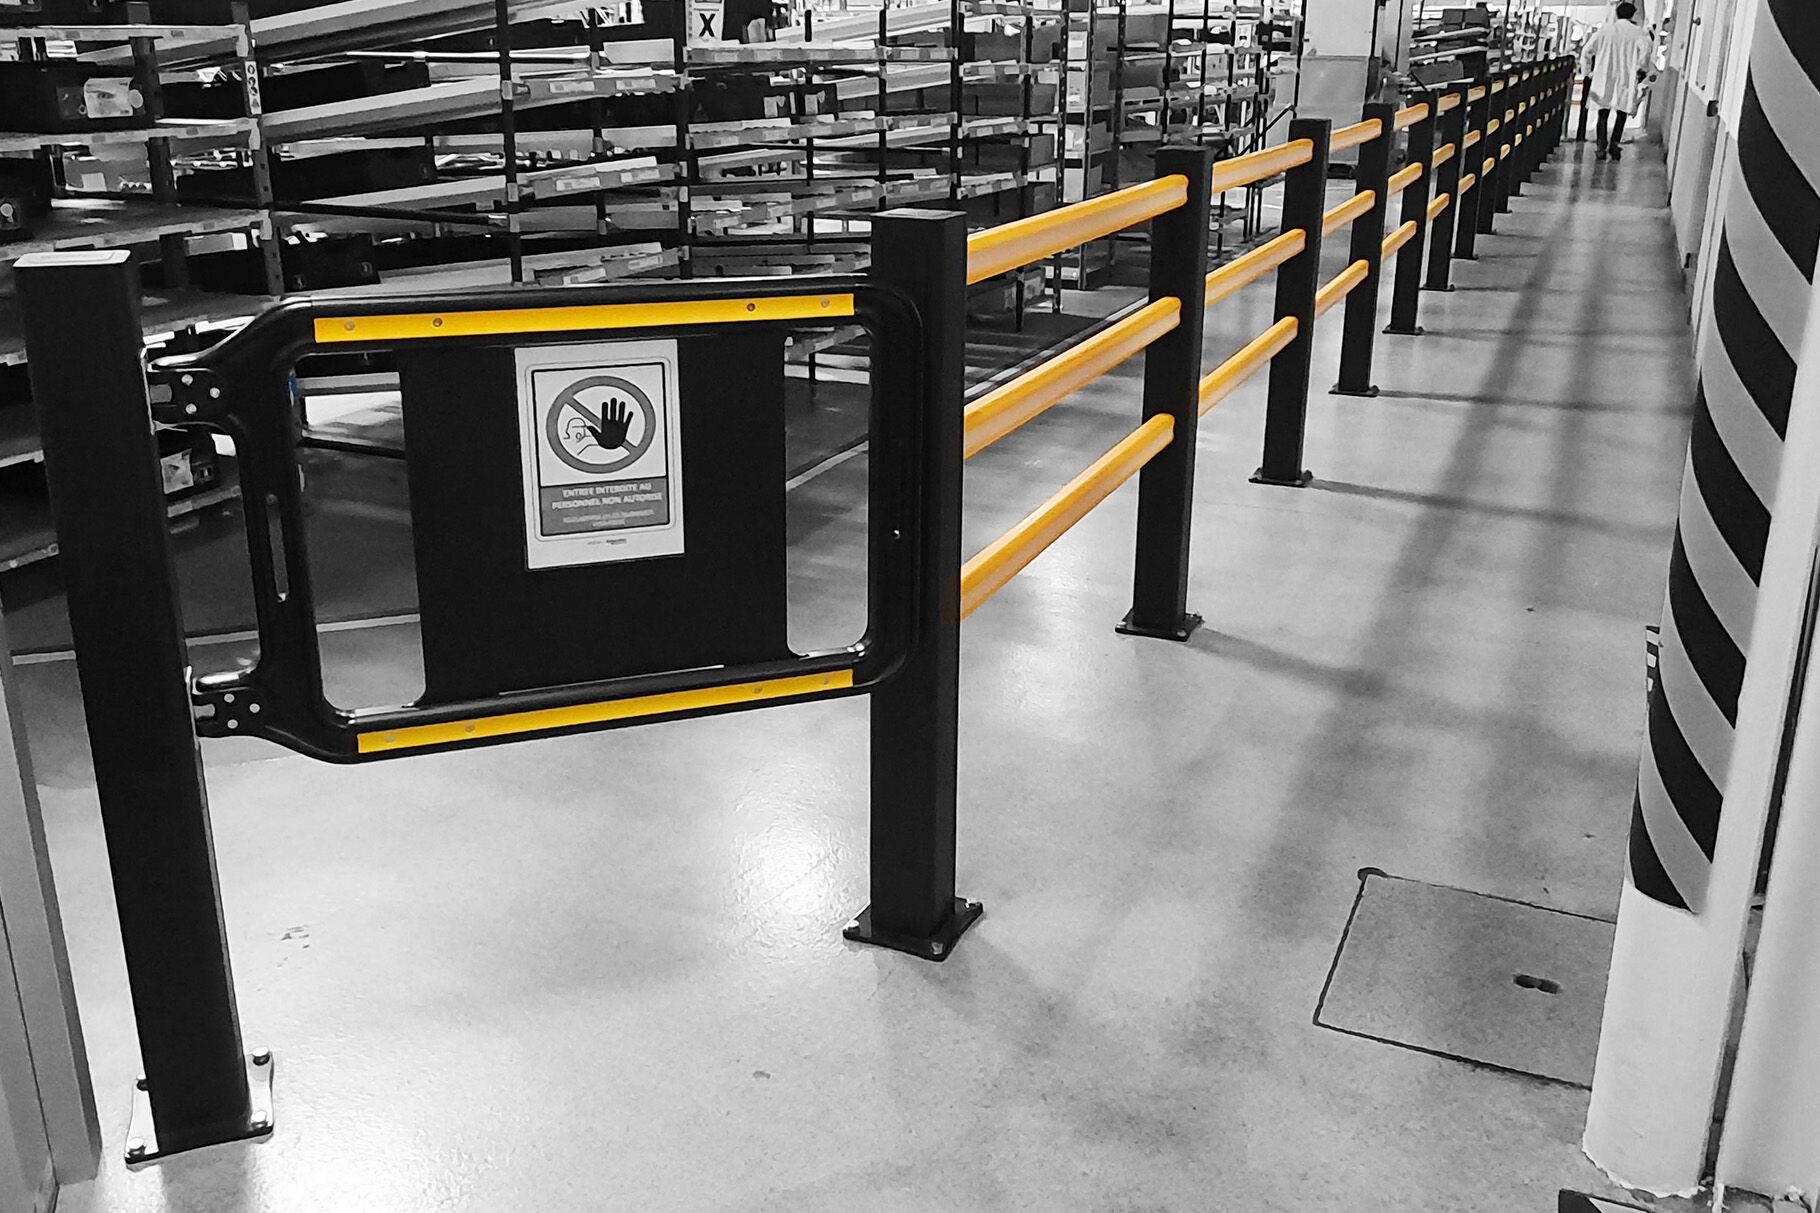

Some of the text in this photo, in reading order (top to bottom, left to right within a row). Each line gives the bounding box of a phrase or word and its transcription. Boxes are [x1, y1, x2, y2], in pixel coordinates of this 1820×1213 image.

[699, 12, 716, 38] X
[639, 482, 652, 491] AU
[551, 498, 601, 510] PERSONNEL
[602, 496, 621, 504] NON
